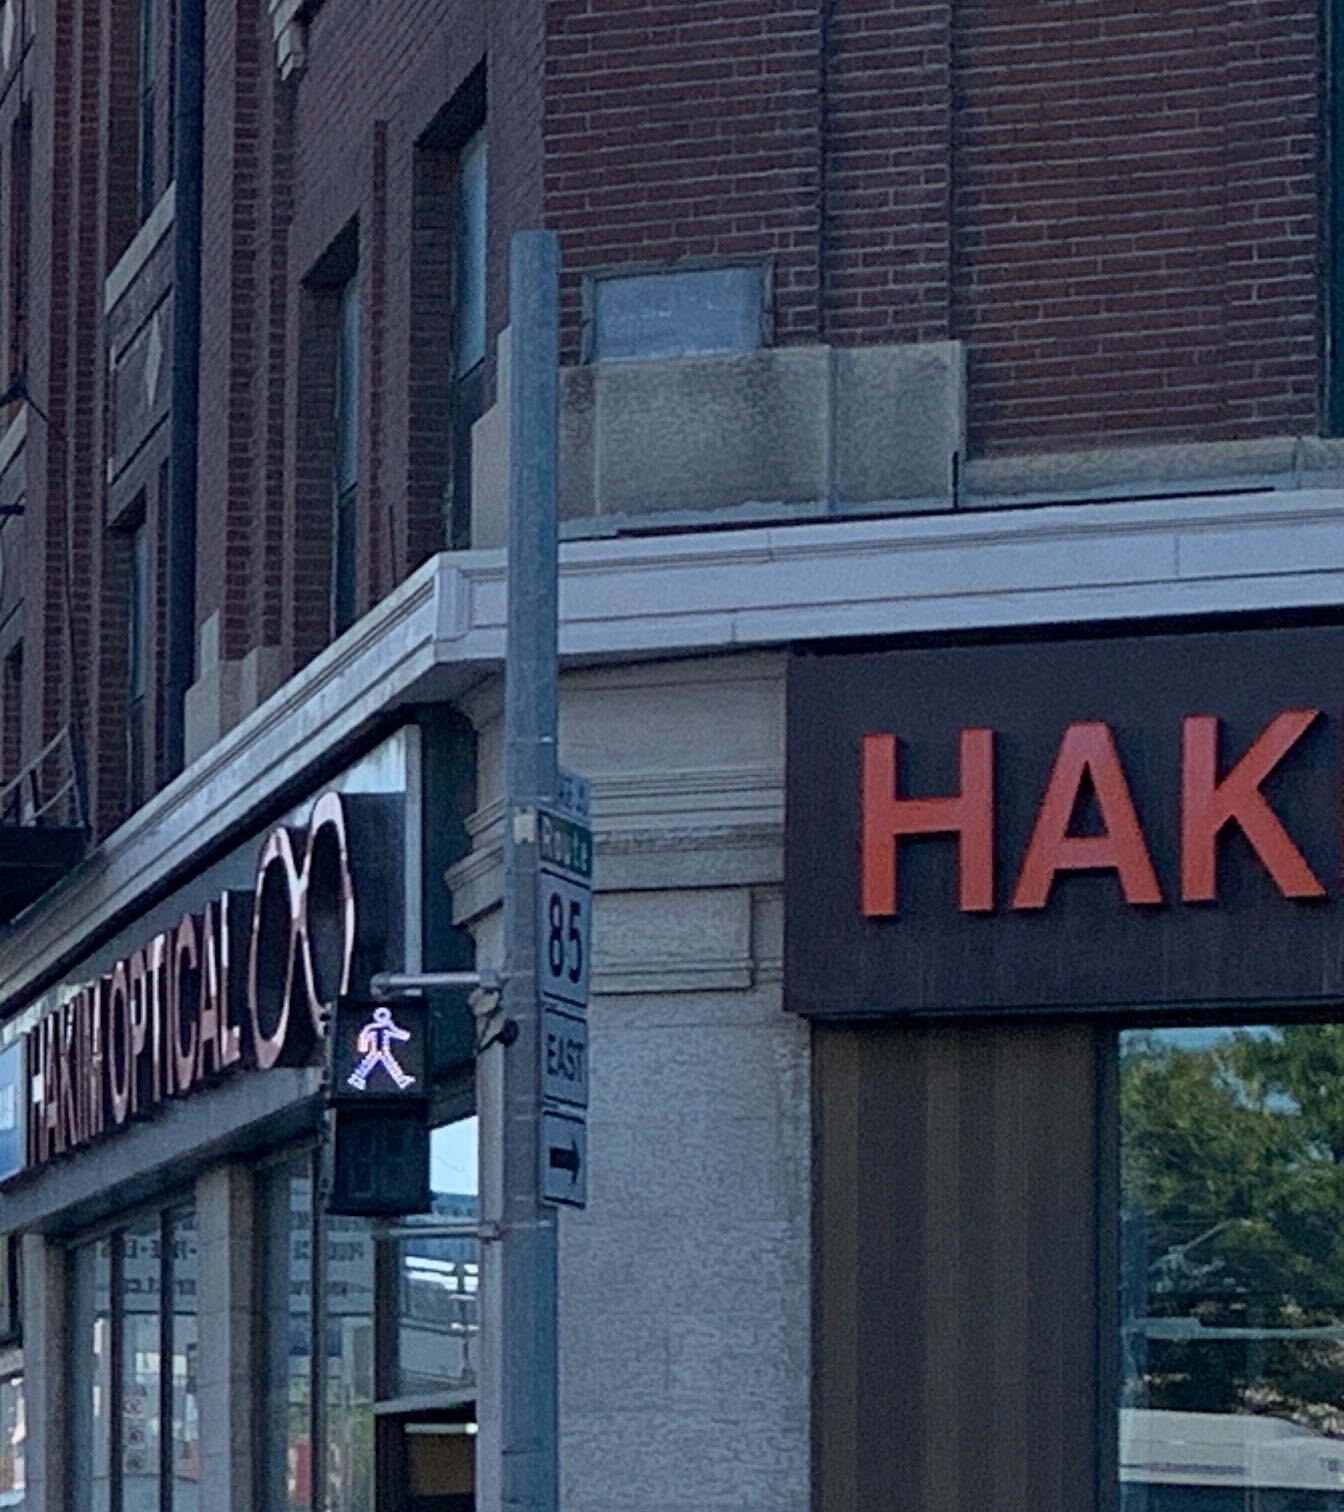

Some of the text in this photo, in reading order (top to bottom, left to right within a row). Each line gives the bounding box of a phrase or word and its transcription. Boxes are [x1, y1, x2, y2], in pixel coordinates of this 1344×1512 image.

[860, 706, 1344, 918] HAK
[108, 889, 241, 1125] OPTICAL
[548, 891, 583, 985] 85
[547, 1033, 584, 1083] EAST
